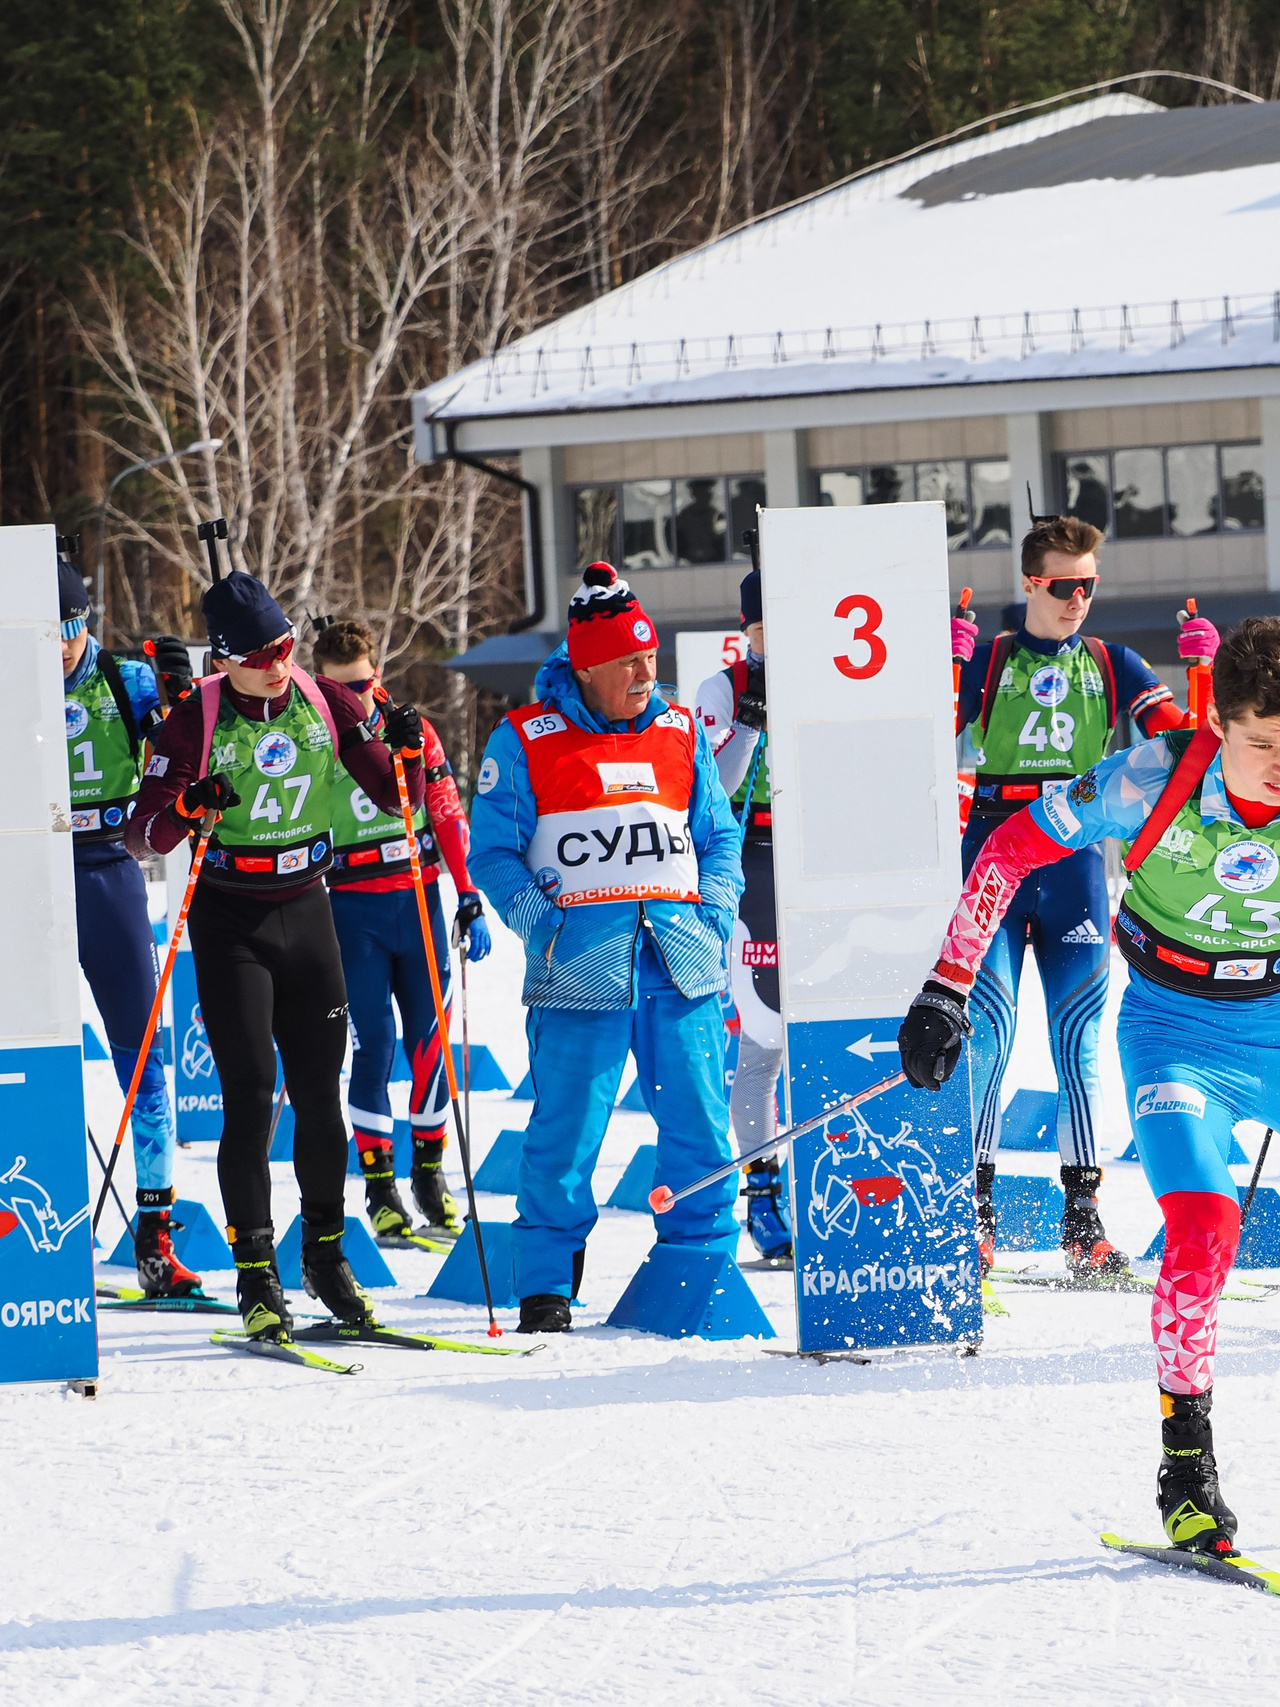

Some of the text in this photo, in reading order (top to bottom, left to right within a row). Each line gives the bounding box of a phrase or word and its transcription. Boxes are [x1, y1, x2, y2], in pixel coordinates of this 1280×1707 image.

[833, 594, 887, 680] 3
[721, 636, 741, 666] 5
[530, 716, 557, 734] 35
[1018, 710, 1076, 752] 48
[1019, 759, 1074, 768] КРАСНОЯРС
[70, 787, 102, 798] ОЯРСК
[250, 774, 312, 824] 47
[1045, 800, 1070, 838] GAZPROM
[252, 824, 313, 841] КРАСНОЯРСК
[357, 820, 406, 838] КРАСНОЯРС
[1061, 933, 1104, 945] adidas
[745, 943, 776, 954] BIV
[745, 953, 776, 965] IUM
[1153, 1099, 1202, 1115] GAZPROM
[143, 1193, 160, 1202] 201
[803, 1262, 978, 1297] КРАСНОЯРСК
